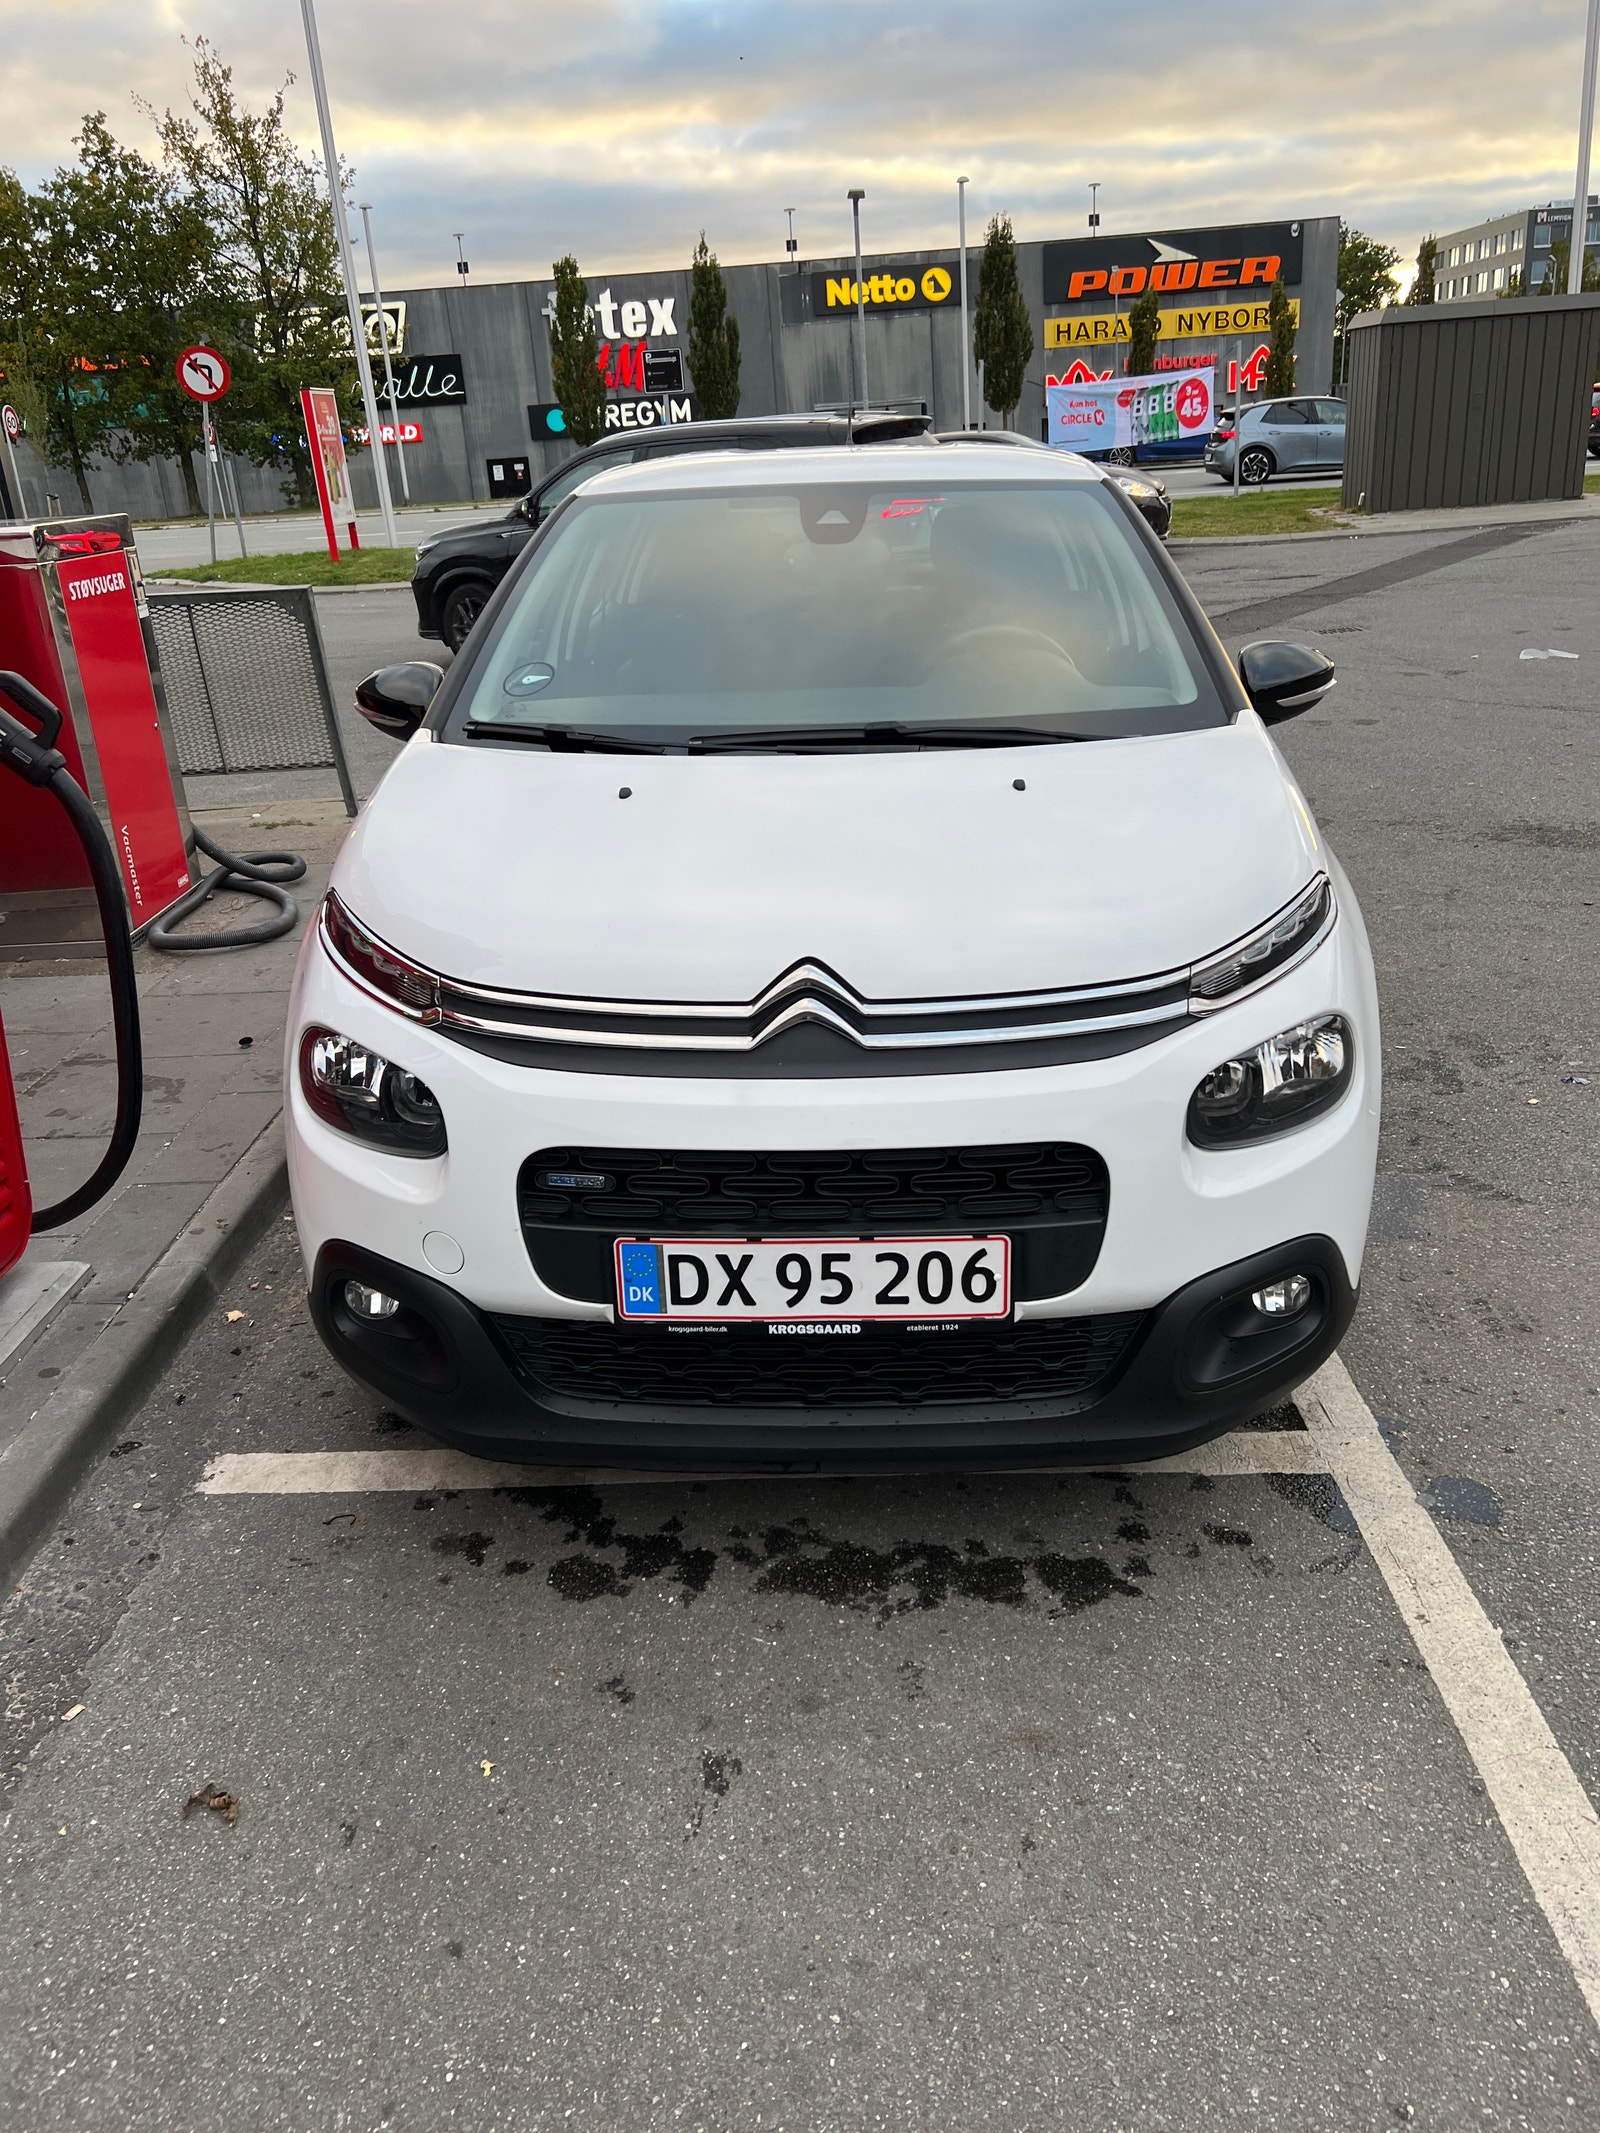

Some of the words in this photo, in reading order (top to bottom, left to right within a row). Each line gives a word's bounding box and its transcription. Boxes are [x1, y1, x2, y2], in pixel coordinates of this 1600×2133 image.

[1068, 255, 1280, 298] POWER
[826, 274, 915, 307] Netto
[1177, 307, 1270, 332] NYBOR
[1186, 386, 1192, 396] 3
[1061, 413, 1092, 425] CIRCLE
[1094, 409, 1105, 426] K
[68, 572, 126, 601] STØVSUGER
[121, 825, 143, 906] Vacmaster
[668, 1254, 757, 1306] DX
[776, 1252, 853, 1308] 95
[875, 1247, 997, 1305] 206
[629, 1286, 655, 1302] DK
[668, 1325, 728, 1334] krogsgaard-biler.dk
[768, 1324, 862, 1335] KROGSGAARD
[941, 1323, 959, 1331] 1924
